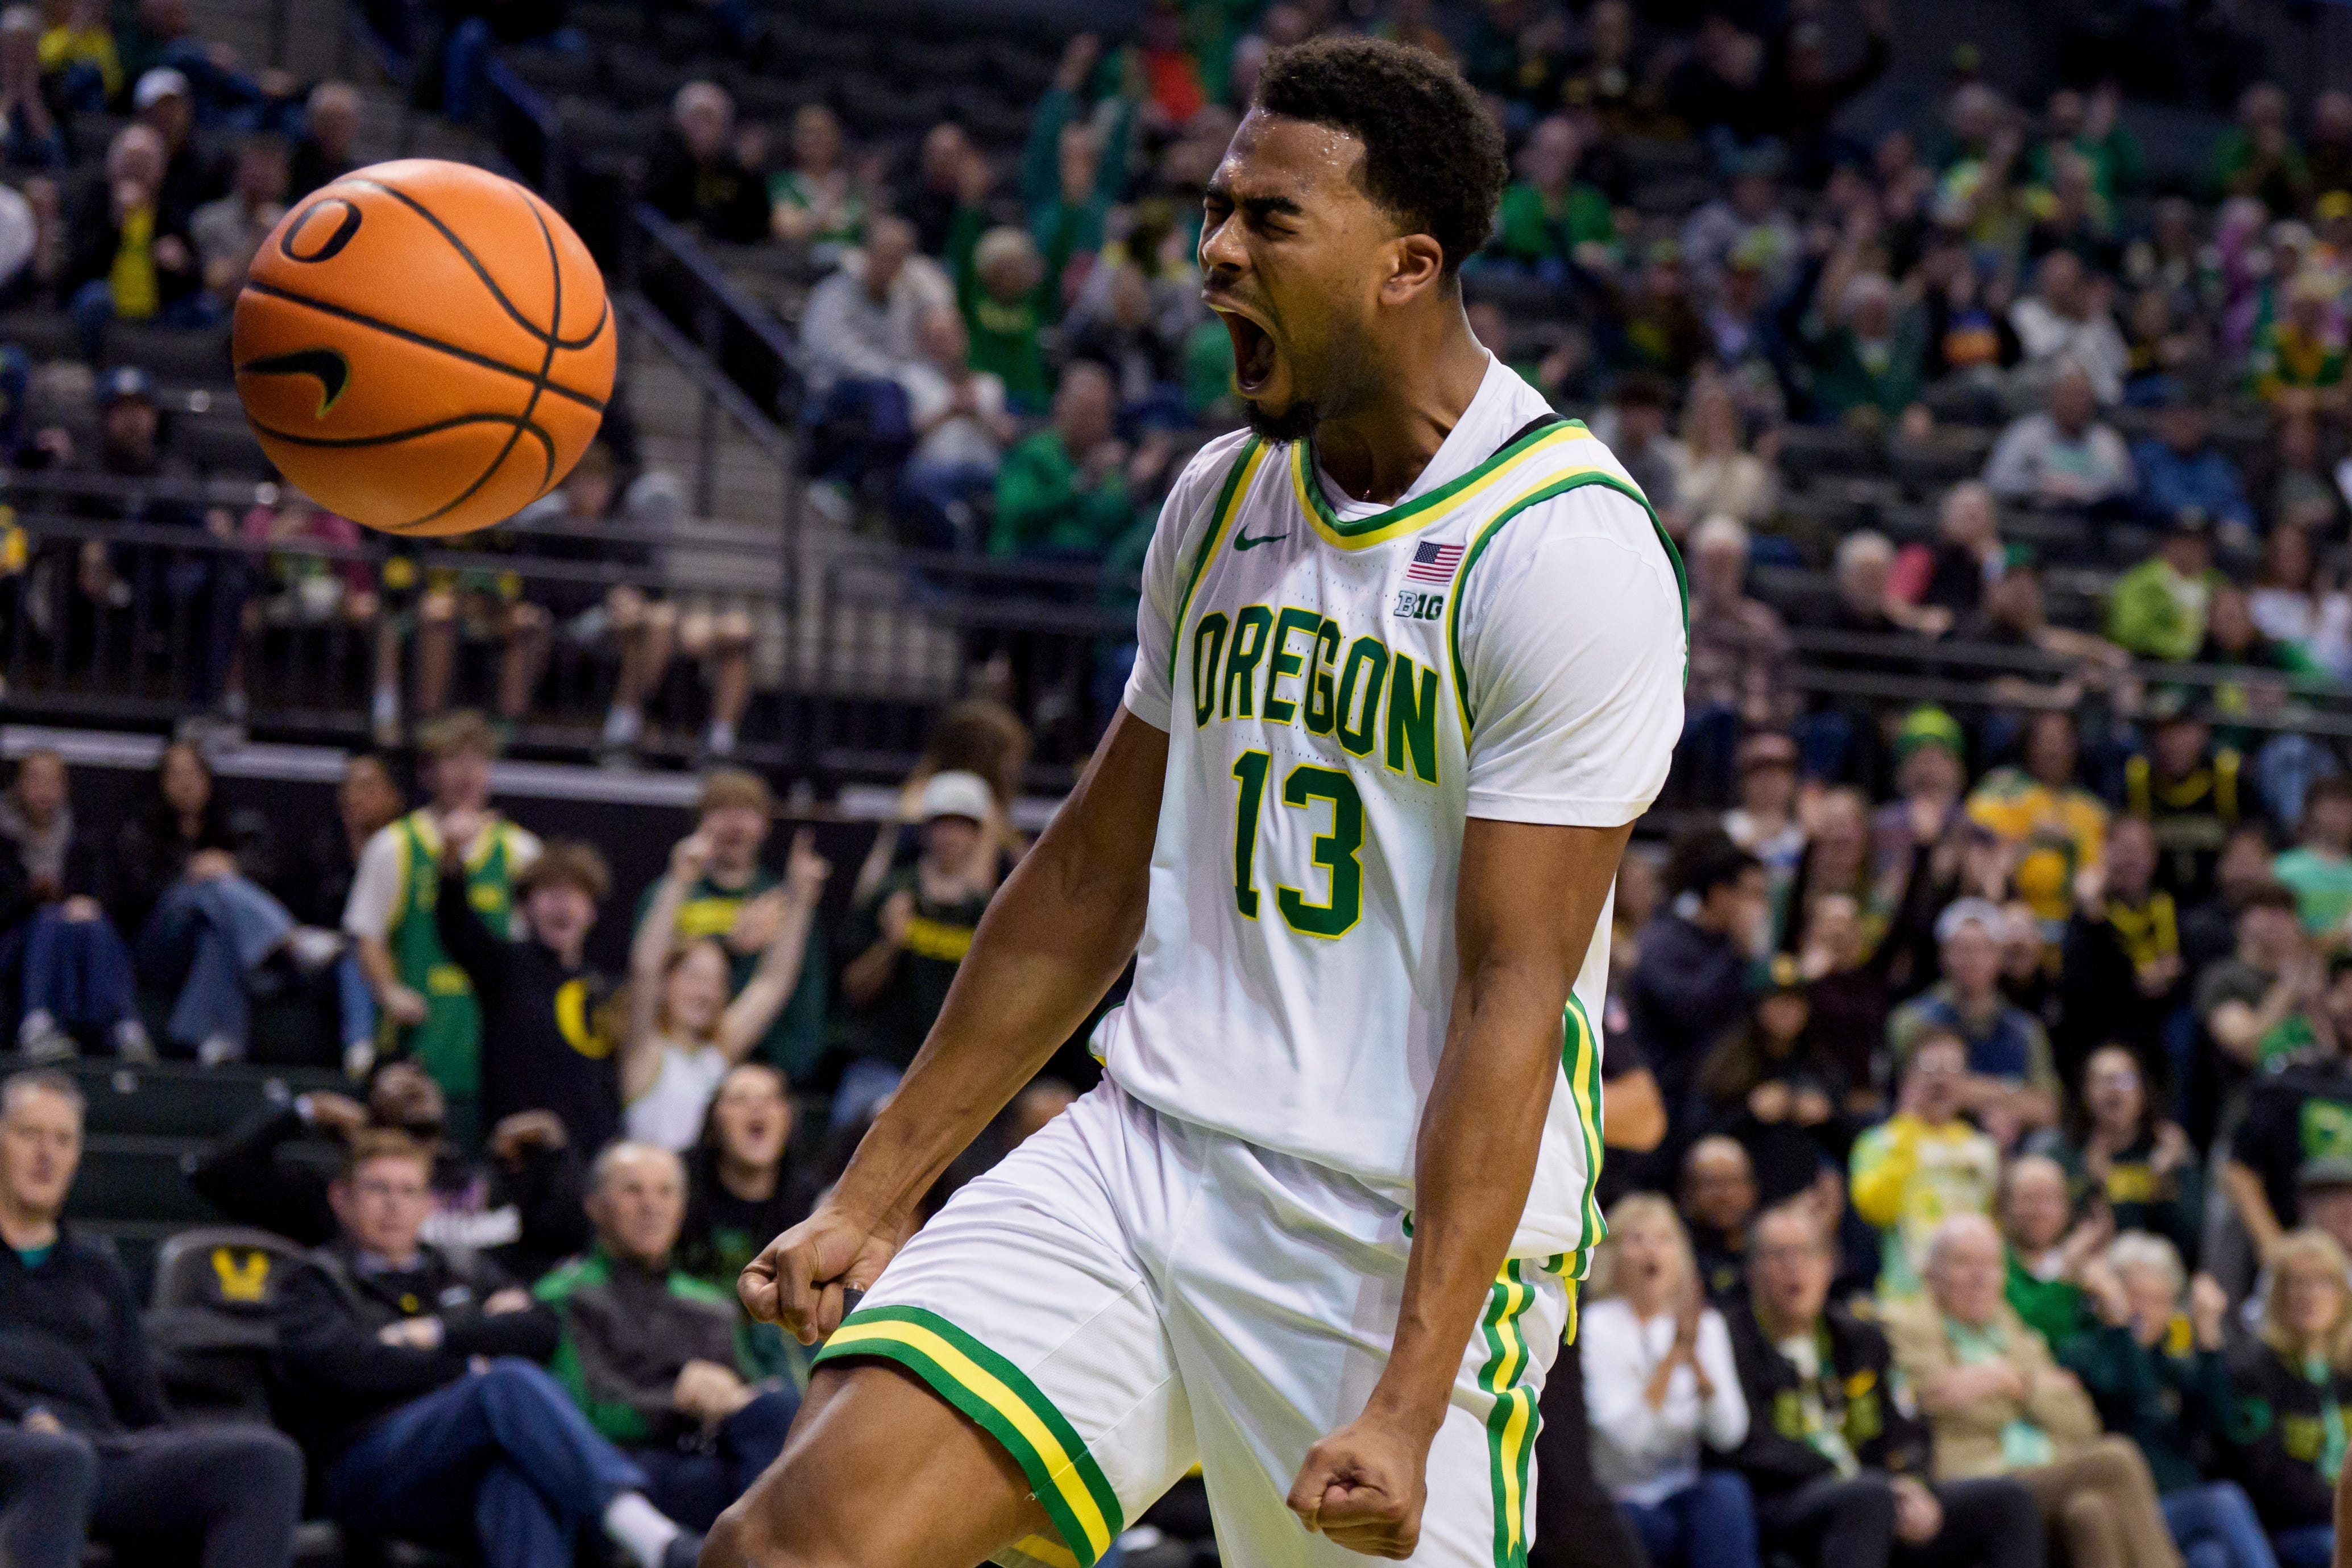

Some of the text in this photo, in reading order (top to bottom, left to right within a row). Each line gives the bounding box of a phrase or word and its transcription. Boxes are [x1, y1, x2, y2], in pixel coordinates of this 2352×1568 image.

[281, 198, 362, 263] O
[1193, 604, 1440, 786] OREGON
[1231, 749, 1364, 939] 13
